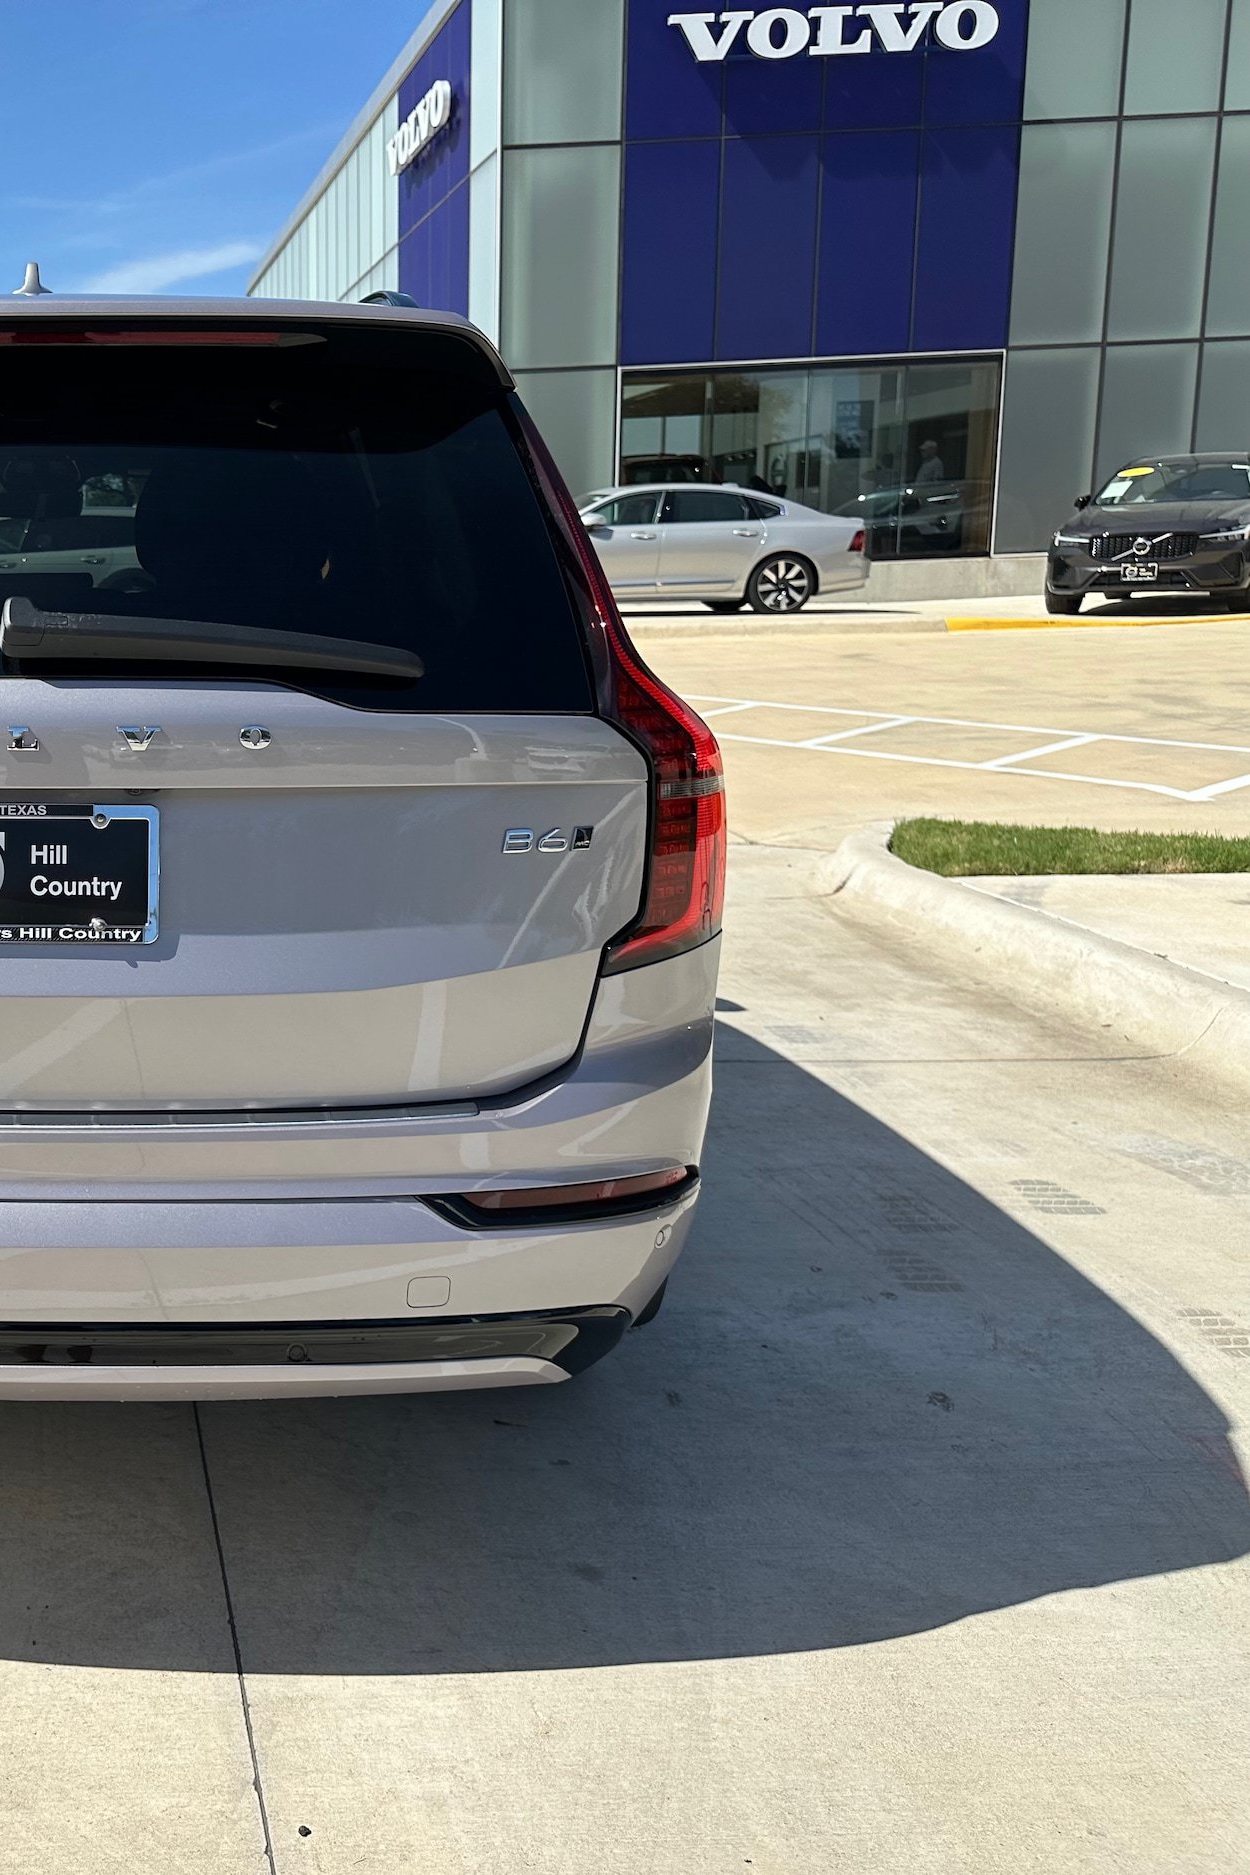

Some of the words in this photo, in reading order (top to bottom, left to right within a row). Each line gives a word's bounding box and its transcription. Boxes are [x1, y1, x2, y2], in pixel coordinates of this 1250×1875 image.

[667, 0, 999, 62] VOLVO
[386, 80, 450, 176] VOLVO
[502, 828, 568, 853] B6
[30, 845, 67, 865] Hill
[30, 875, 122, 900] Country
[20, 927, 52, 939] Hill
[58, 928, 141, 942] Country
